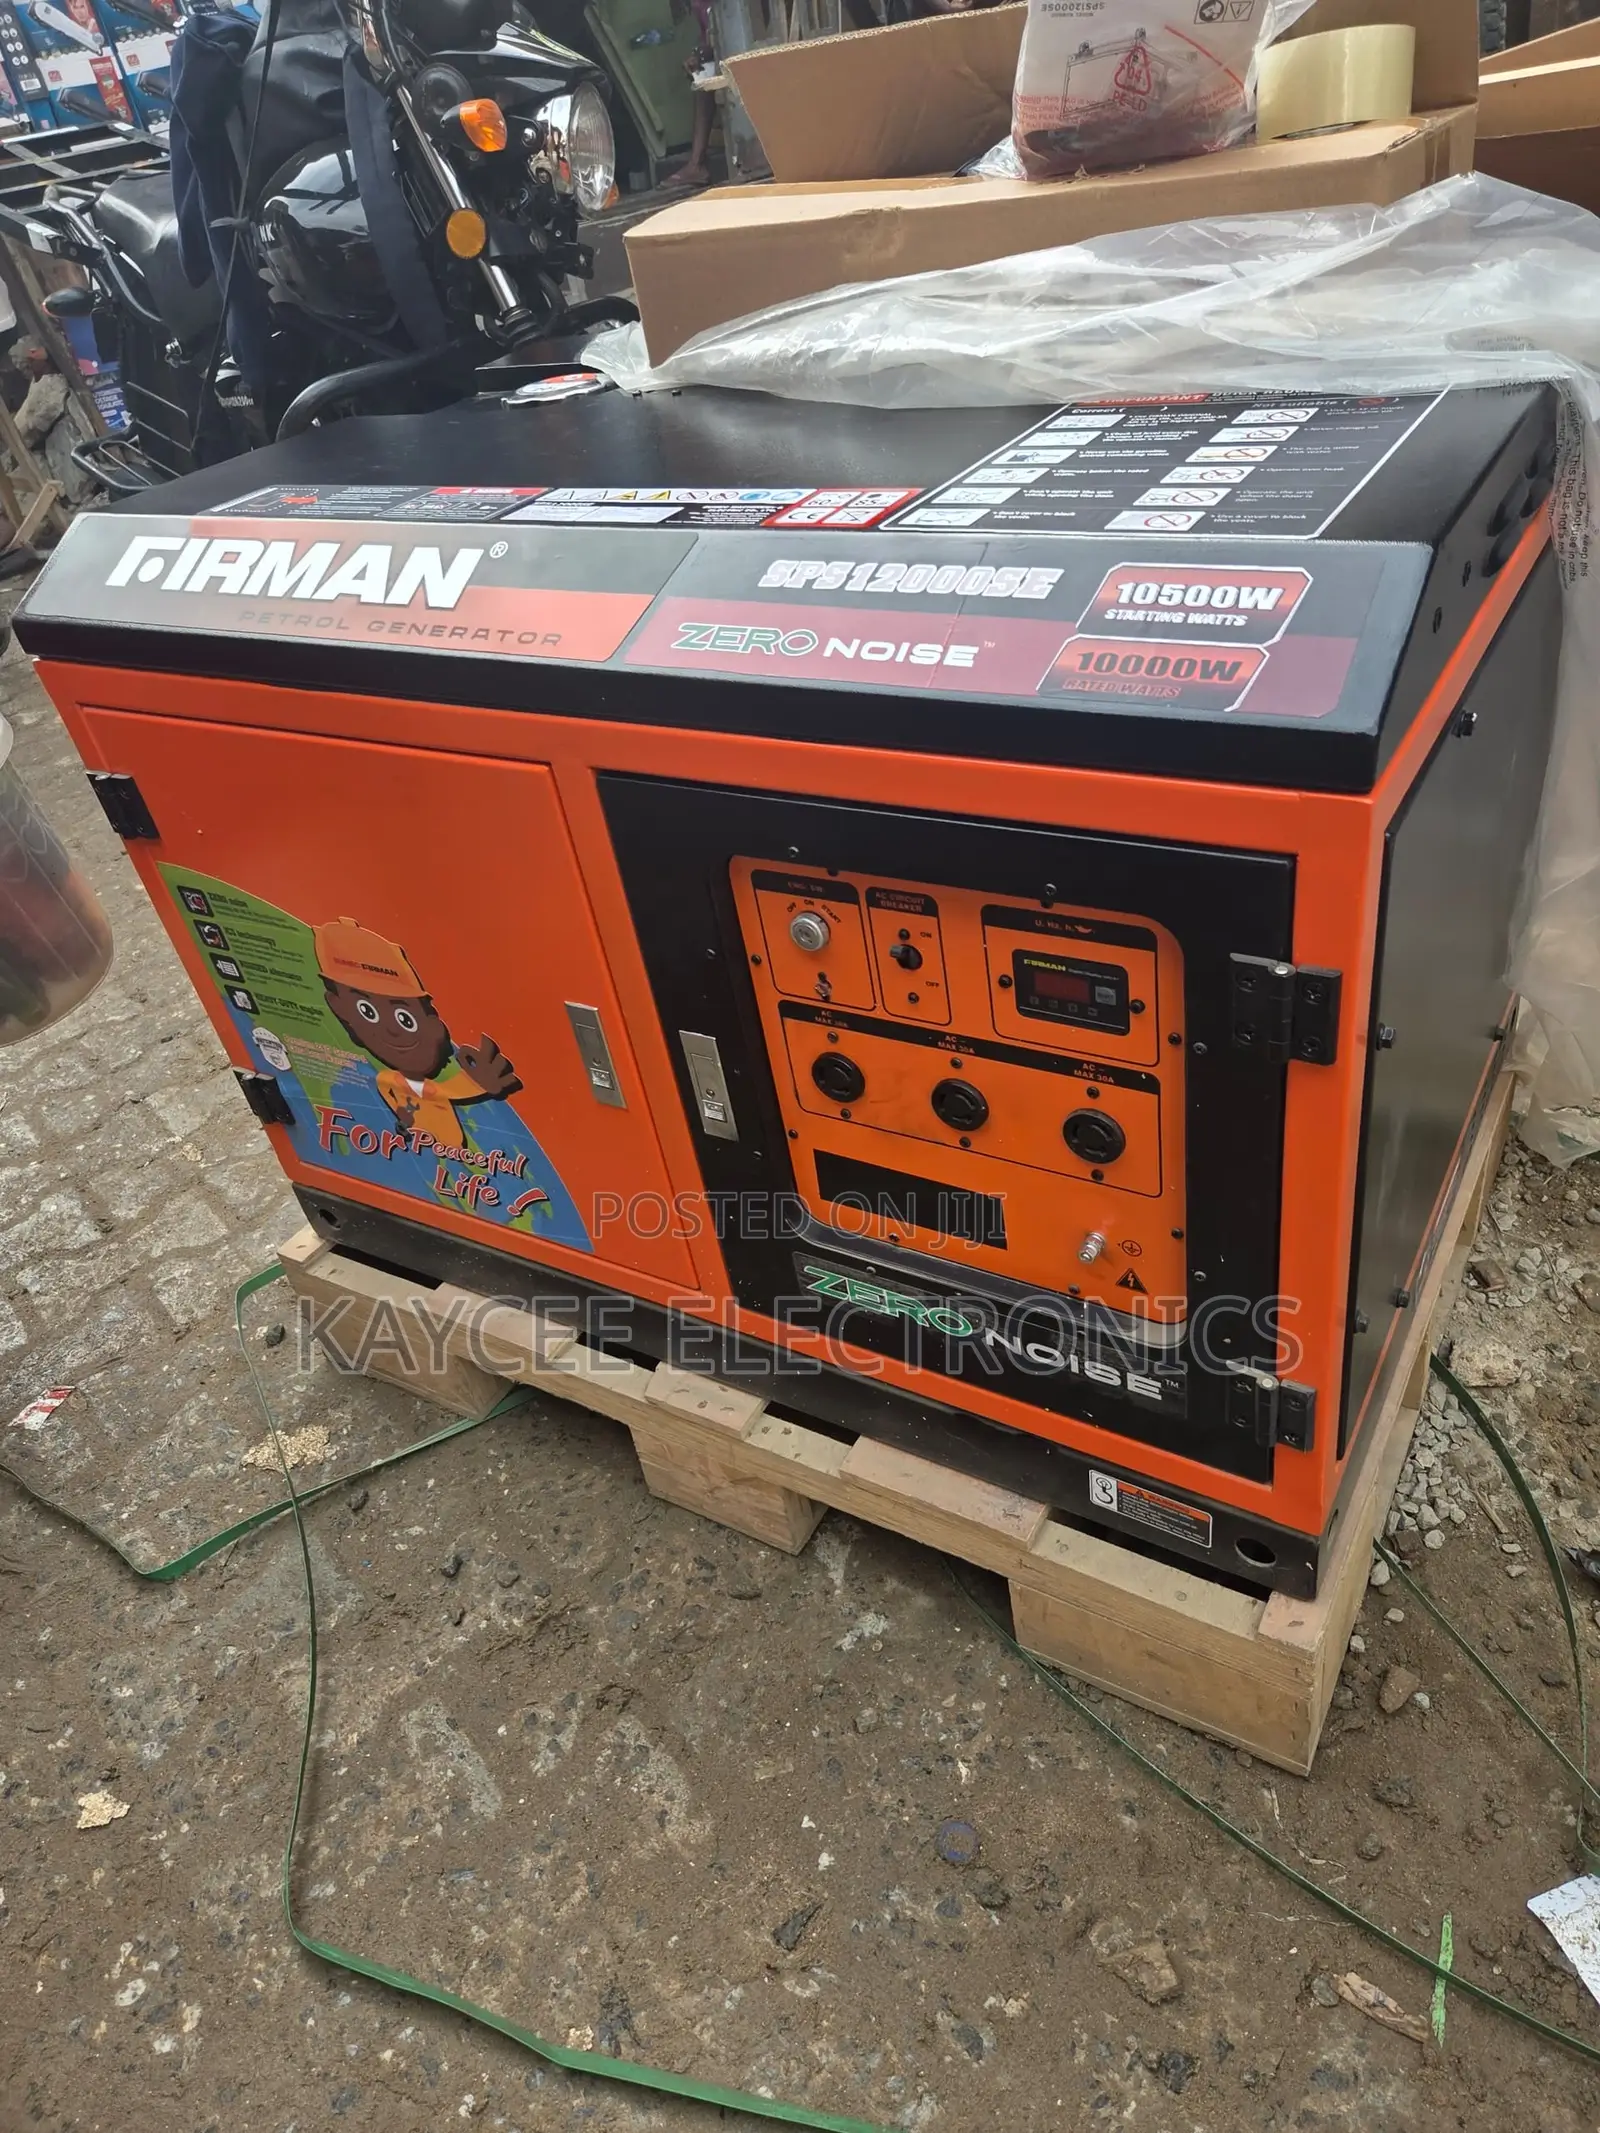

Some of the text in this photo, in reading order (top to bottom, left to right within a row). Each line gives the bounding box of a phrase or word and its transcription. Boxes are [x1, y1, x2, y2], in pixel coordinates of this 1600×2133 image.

[1568, 450, 1581, 476] This
[1562, 478, 1575, 499] bag
[1575, 509, 1583, 527] not
[757, 559, 1065, 600] SPS12000SE
[1115, 582, 1284, 611] 10500W
[1104, 608, 1249, 627] STARTING WATTS
[238, 609, 564, 647] PETROL GENERATOR
[671, 622, 819, 656] ZERO
[1077, 650, 1244, 685] 10000W
[1062, 679, 1182, 699] RATED WATTS
[821, 904, 842, 924] START
[920, 931, 932, 939] ON
[821, 1010, 832, 1018] AC
[937, 1041, 958, 1051] MAX
[944, 1035, 958, 1043] AC
[1074, 1069, 1096, 1080] MAX
[1082, 1062, 1096, 1071] AC
[314, 1104, 530, 1179] For Peaceful
[433, 1165, 501, 1209] Life
[803, 1265, 974, 1338] ZERO
